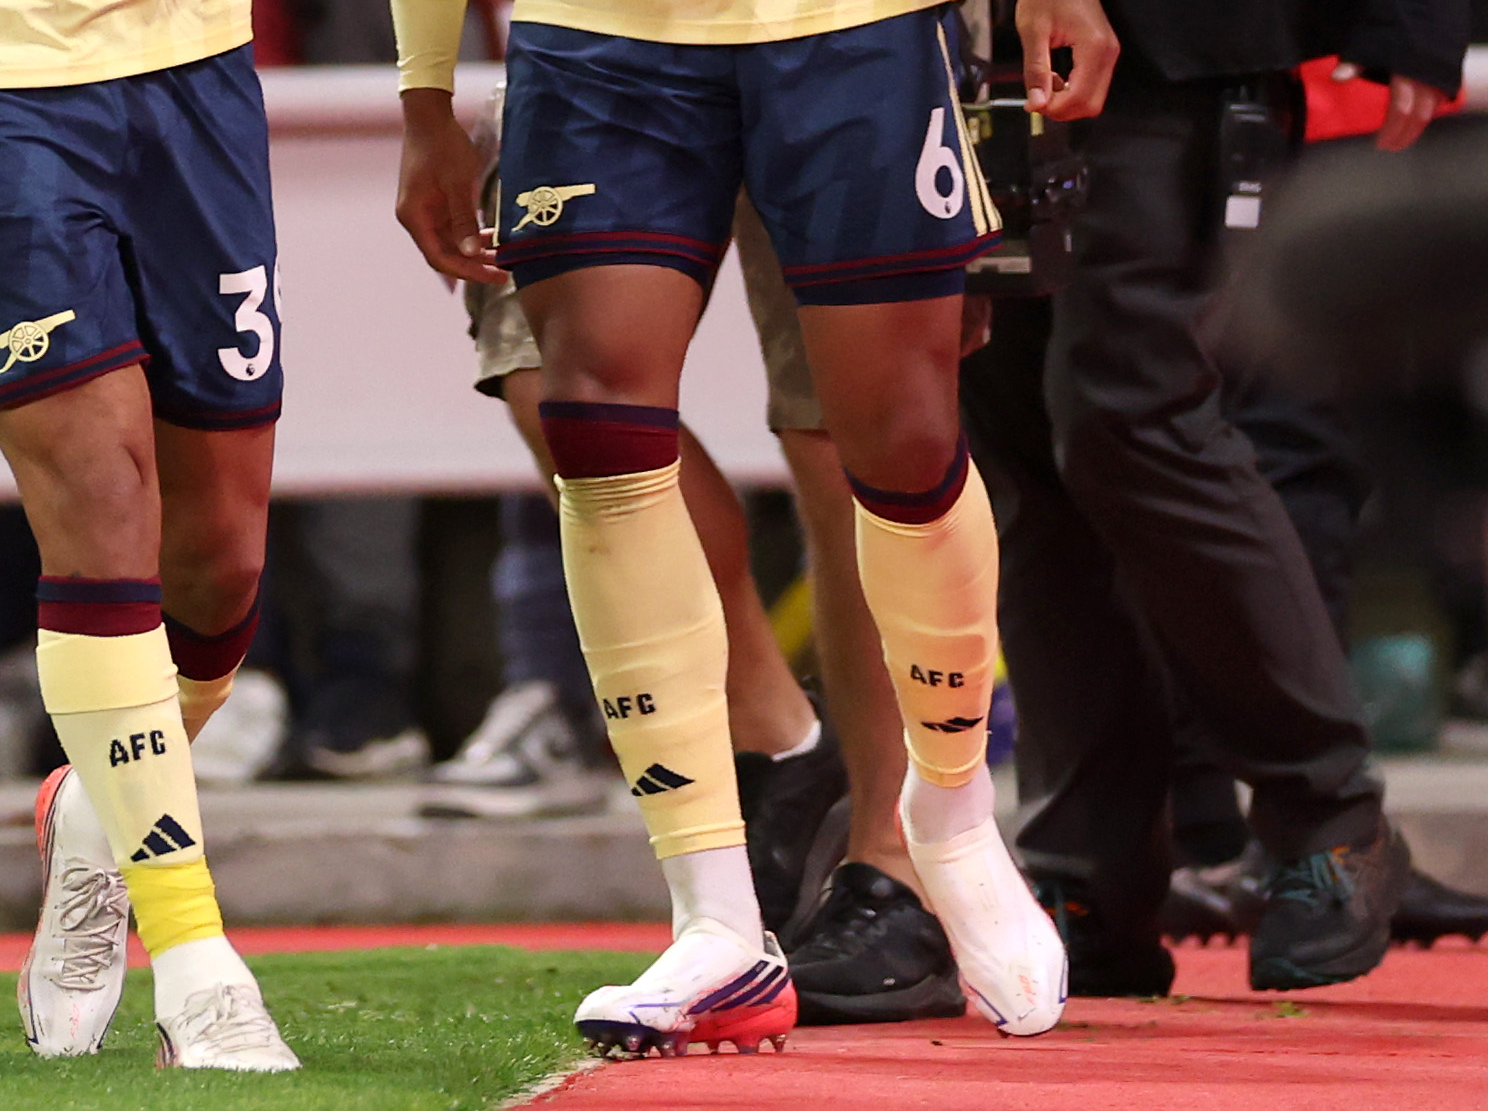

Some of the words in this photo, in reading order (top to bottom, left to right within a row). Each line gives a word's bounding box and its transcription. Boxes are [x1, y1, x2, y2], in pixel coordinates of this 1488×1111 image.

[915, 106, 965, 220] 6
[216, 264, 283, 382] 3
[910, 664, 966, 689] AFC
[602, 692, 657, 720] AFC
[109, 729, 167, 769] AFC
